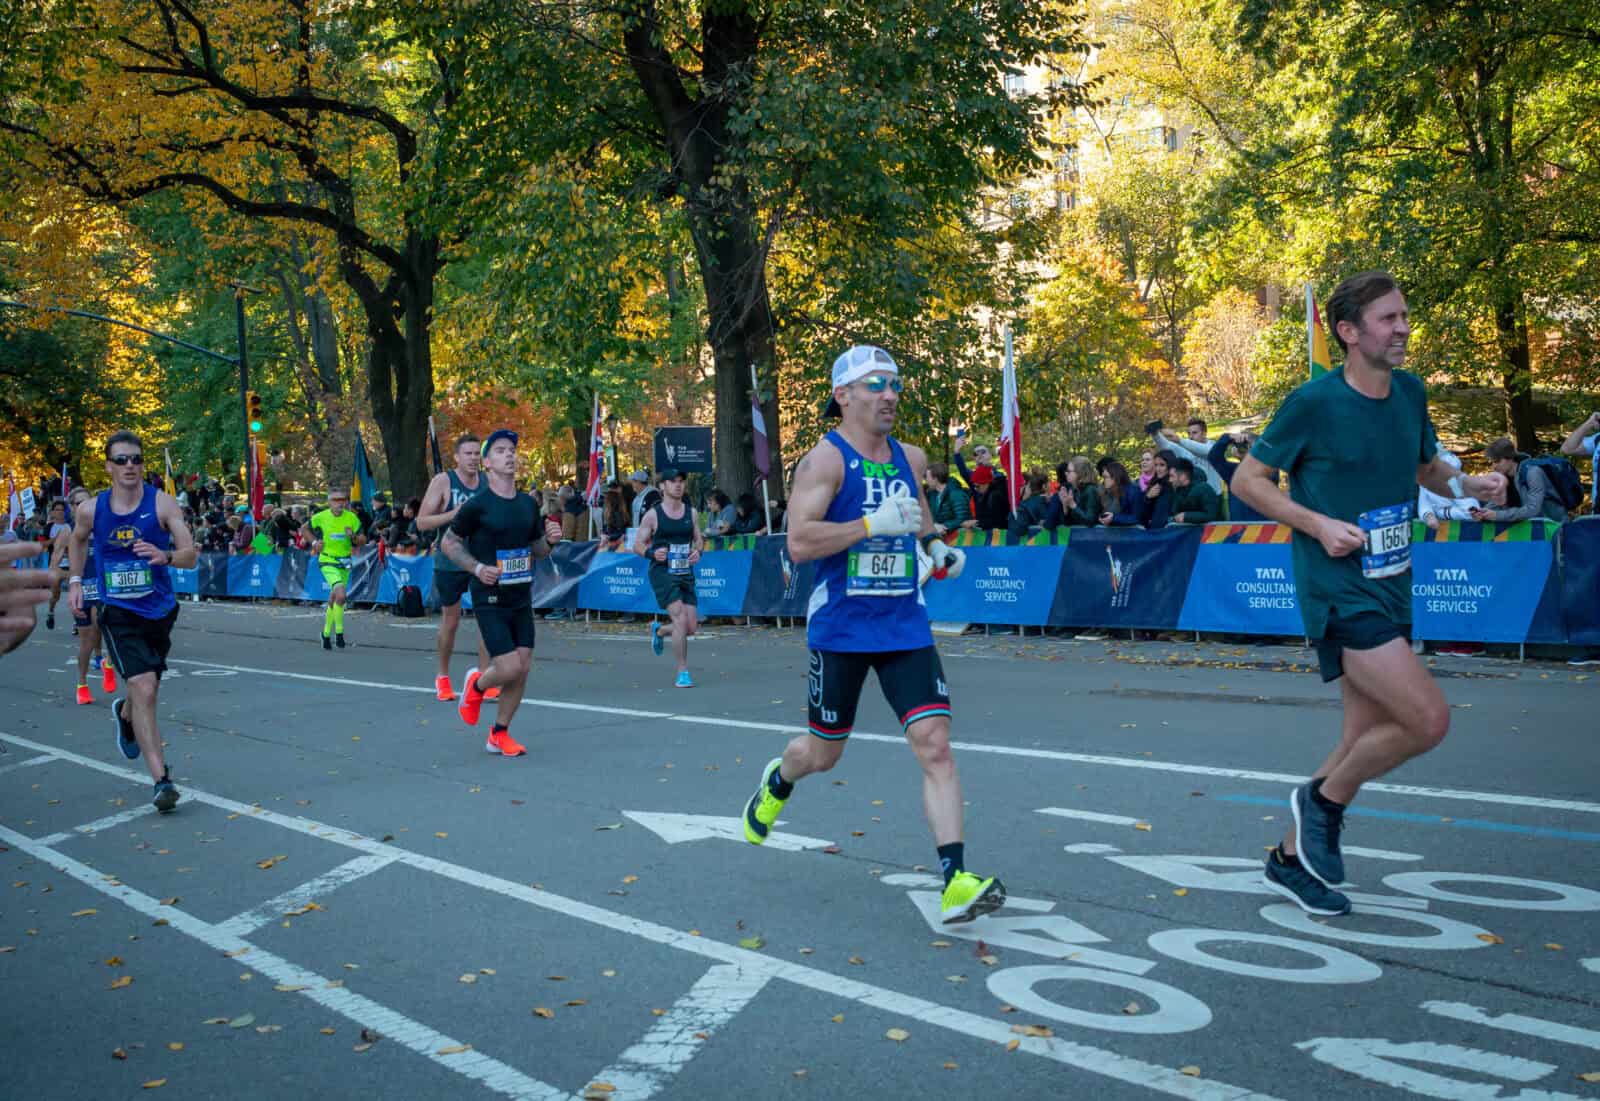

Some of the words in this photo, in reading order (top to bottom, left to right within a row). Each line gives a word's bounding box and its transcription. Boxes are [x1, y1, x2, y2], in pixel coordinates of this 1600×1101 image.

[871, 554, 897, 575] 647
[615, 567, 634, 576] TATA
[700, 568, 716, 577] TATA
[988, 567, 1010, 577] TATA
[1255, 567, 1286, 579] TATA
[1433, 568, 1469, 581] TATA
[117, 572, 139, 586] 3167
[975, 579, 1026, 591] CONSULTANCY
[984, 591, 1018, 602] SERVICES
[1411, 583, 1493, 598] CONSULTANCY
[1248, 597, 1295, 609] SERVICES
[1426, 600, 1478, 613] SERVICES
